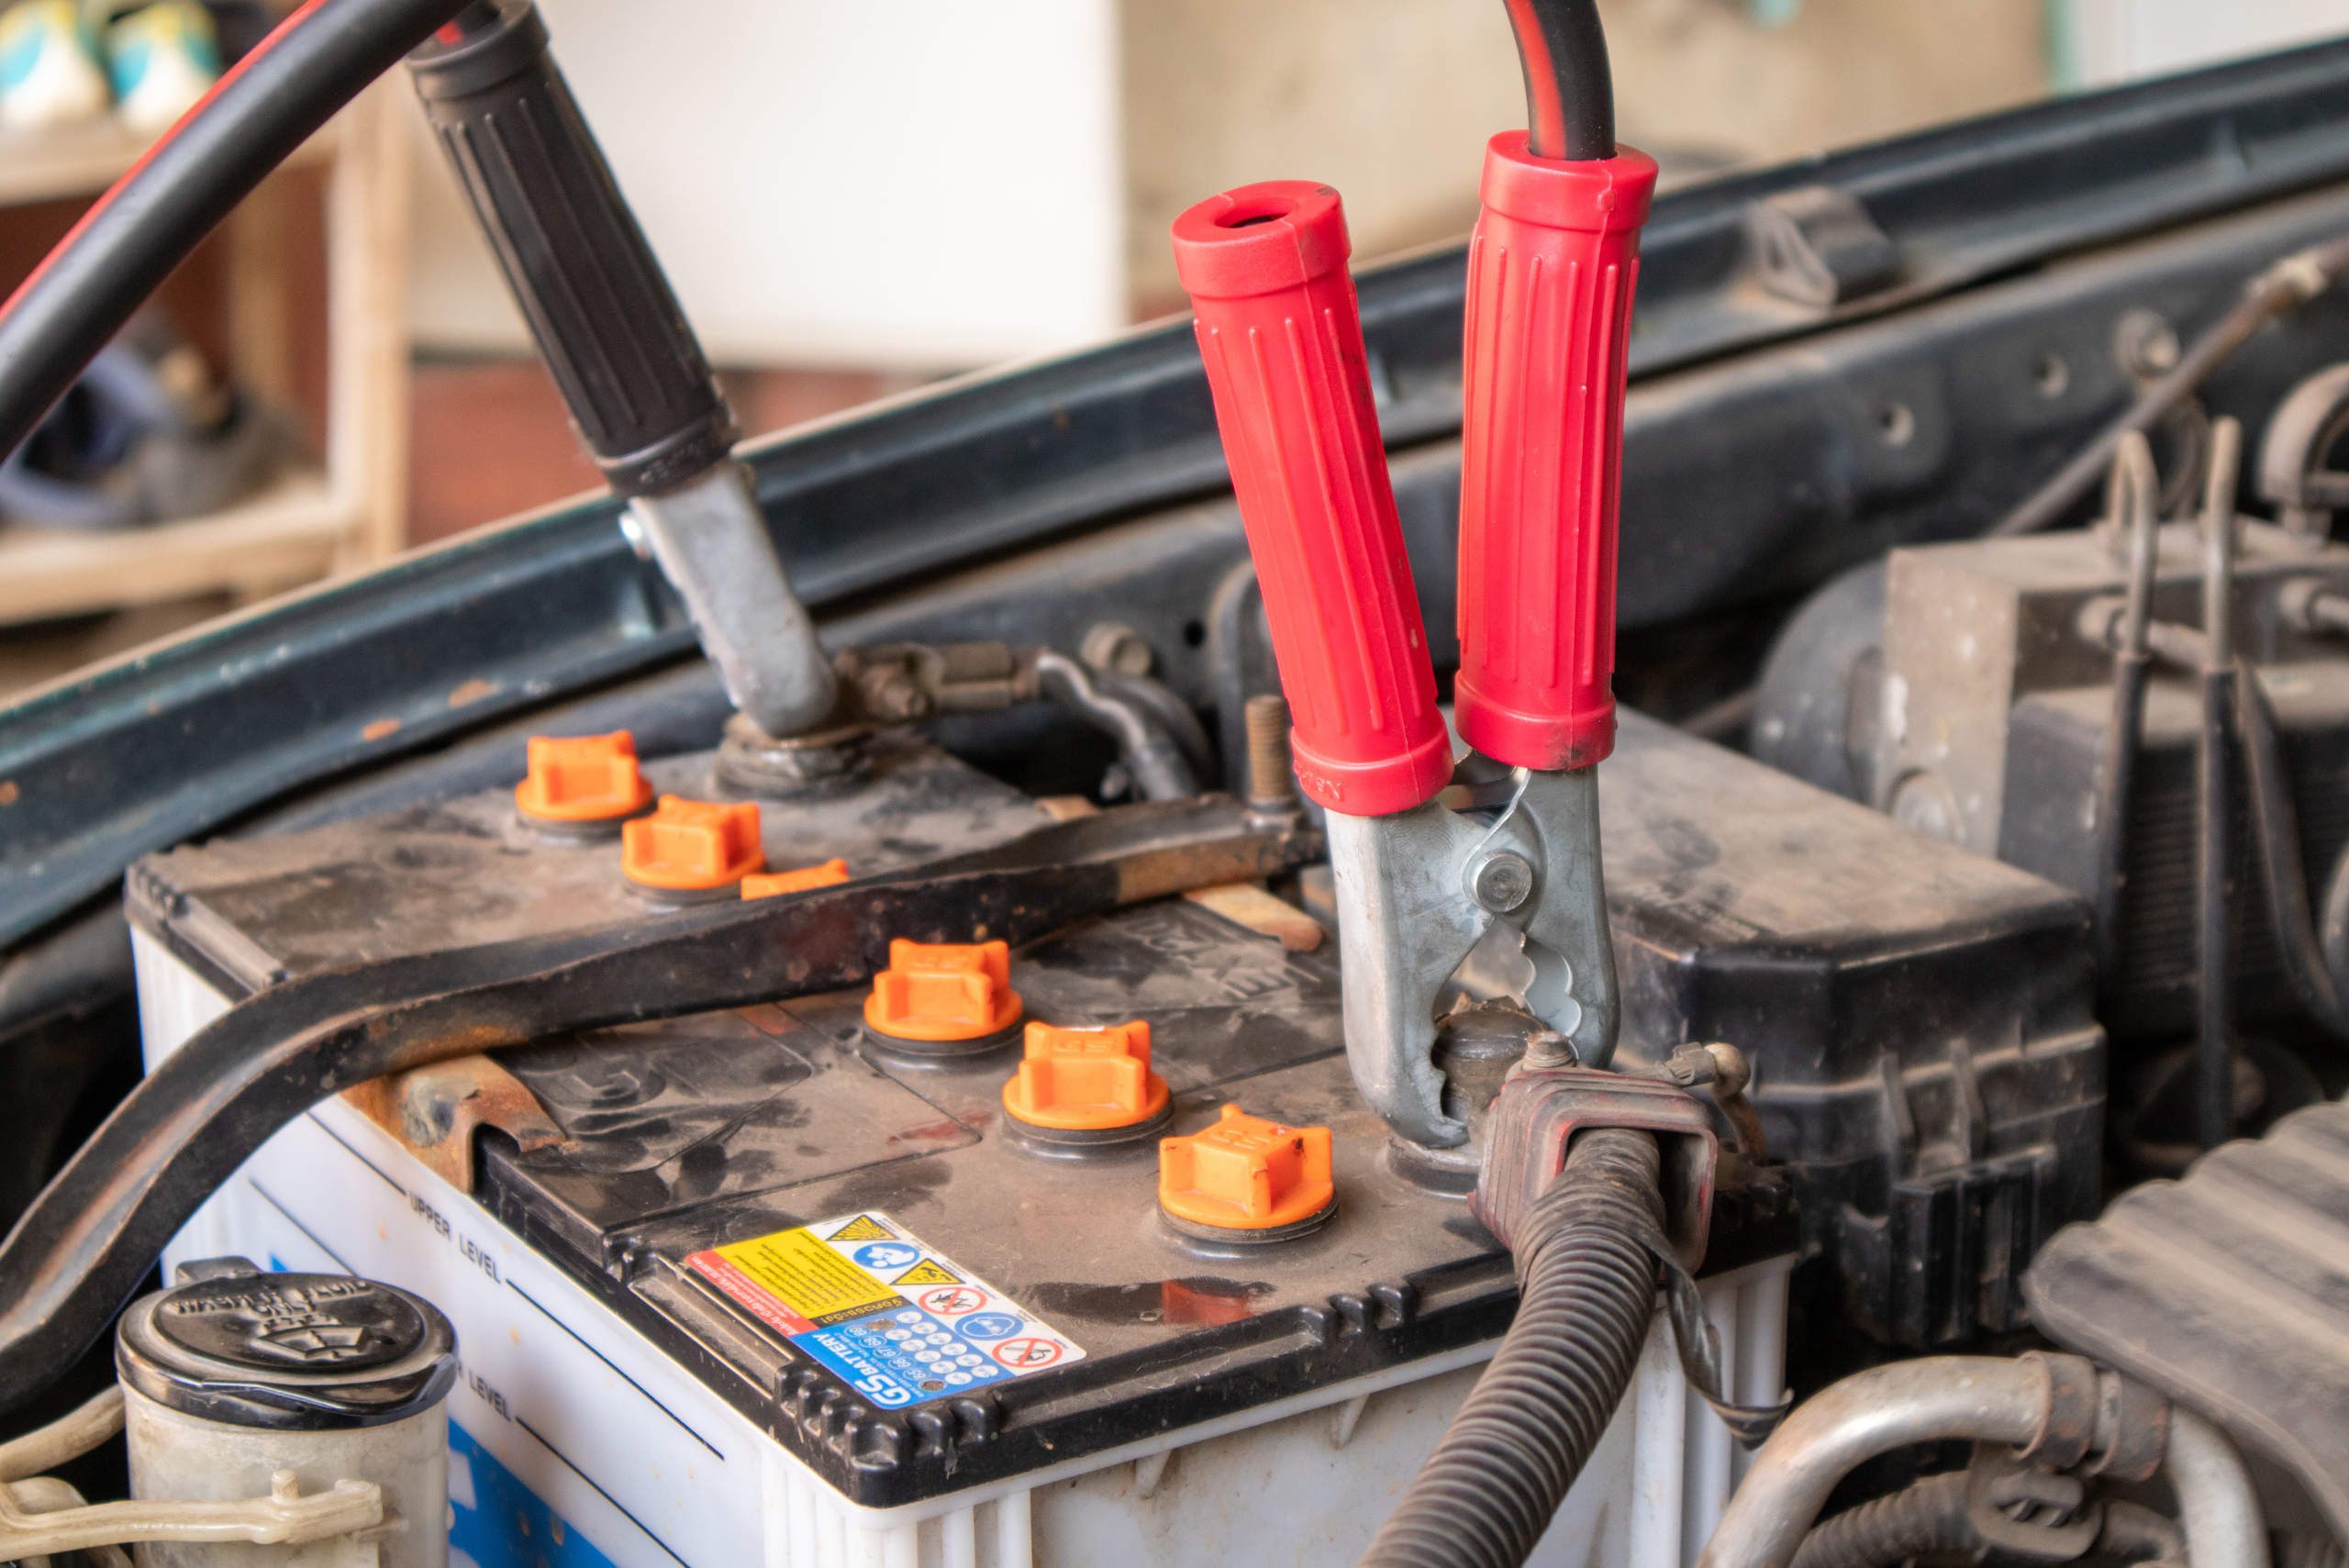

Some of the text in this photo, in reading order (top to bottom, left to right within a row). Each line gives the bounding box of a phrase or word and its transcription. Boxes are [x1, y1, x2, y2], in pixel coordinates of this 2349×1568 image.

[1052, 1040, 1116, 1053] GS
[1210, 1129, 1271, 1151] GS
[409, 1191, 502, 1285] UPPER LEVEL
[697, 1263, 724, 1278] 20,000
[163, 1281, 369, 1315] WASHER FLUID
[253, 1299, 317, 1318] ONLY
[819, 1297, 903, 1324] ข้อควรระวัง!
[861, 1336, 884, 1347] 68
[875, 1347, 897, 1357] 67
[810, 1331, 913, 1406] GS BATTERY
[890, 1357, 913, 1368] 66
[905, 1368, 929, 1379] 65
[468, 1369, 512, 1422] LEVEL
